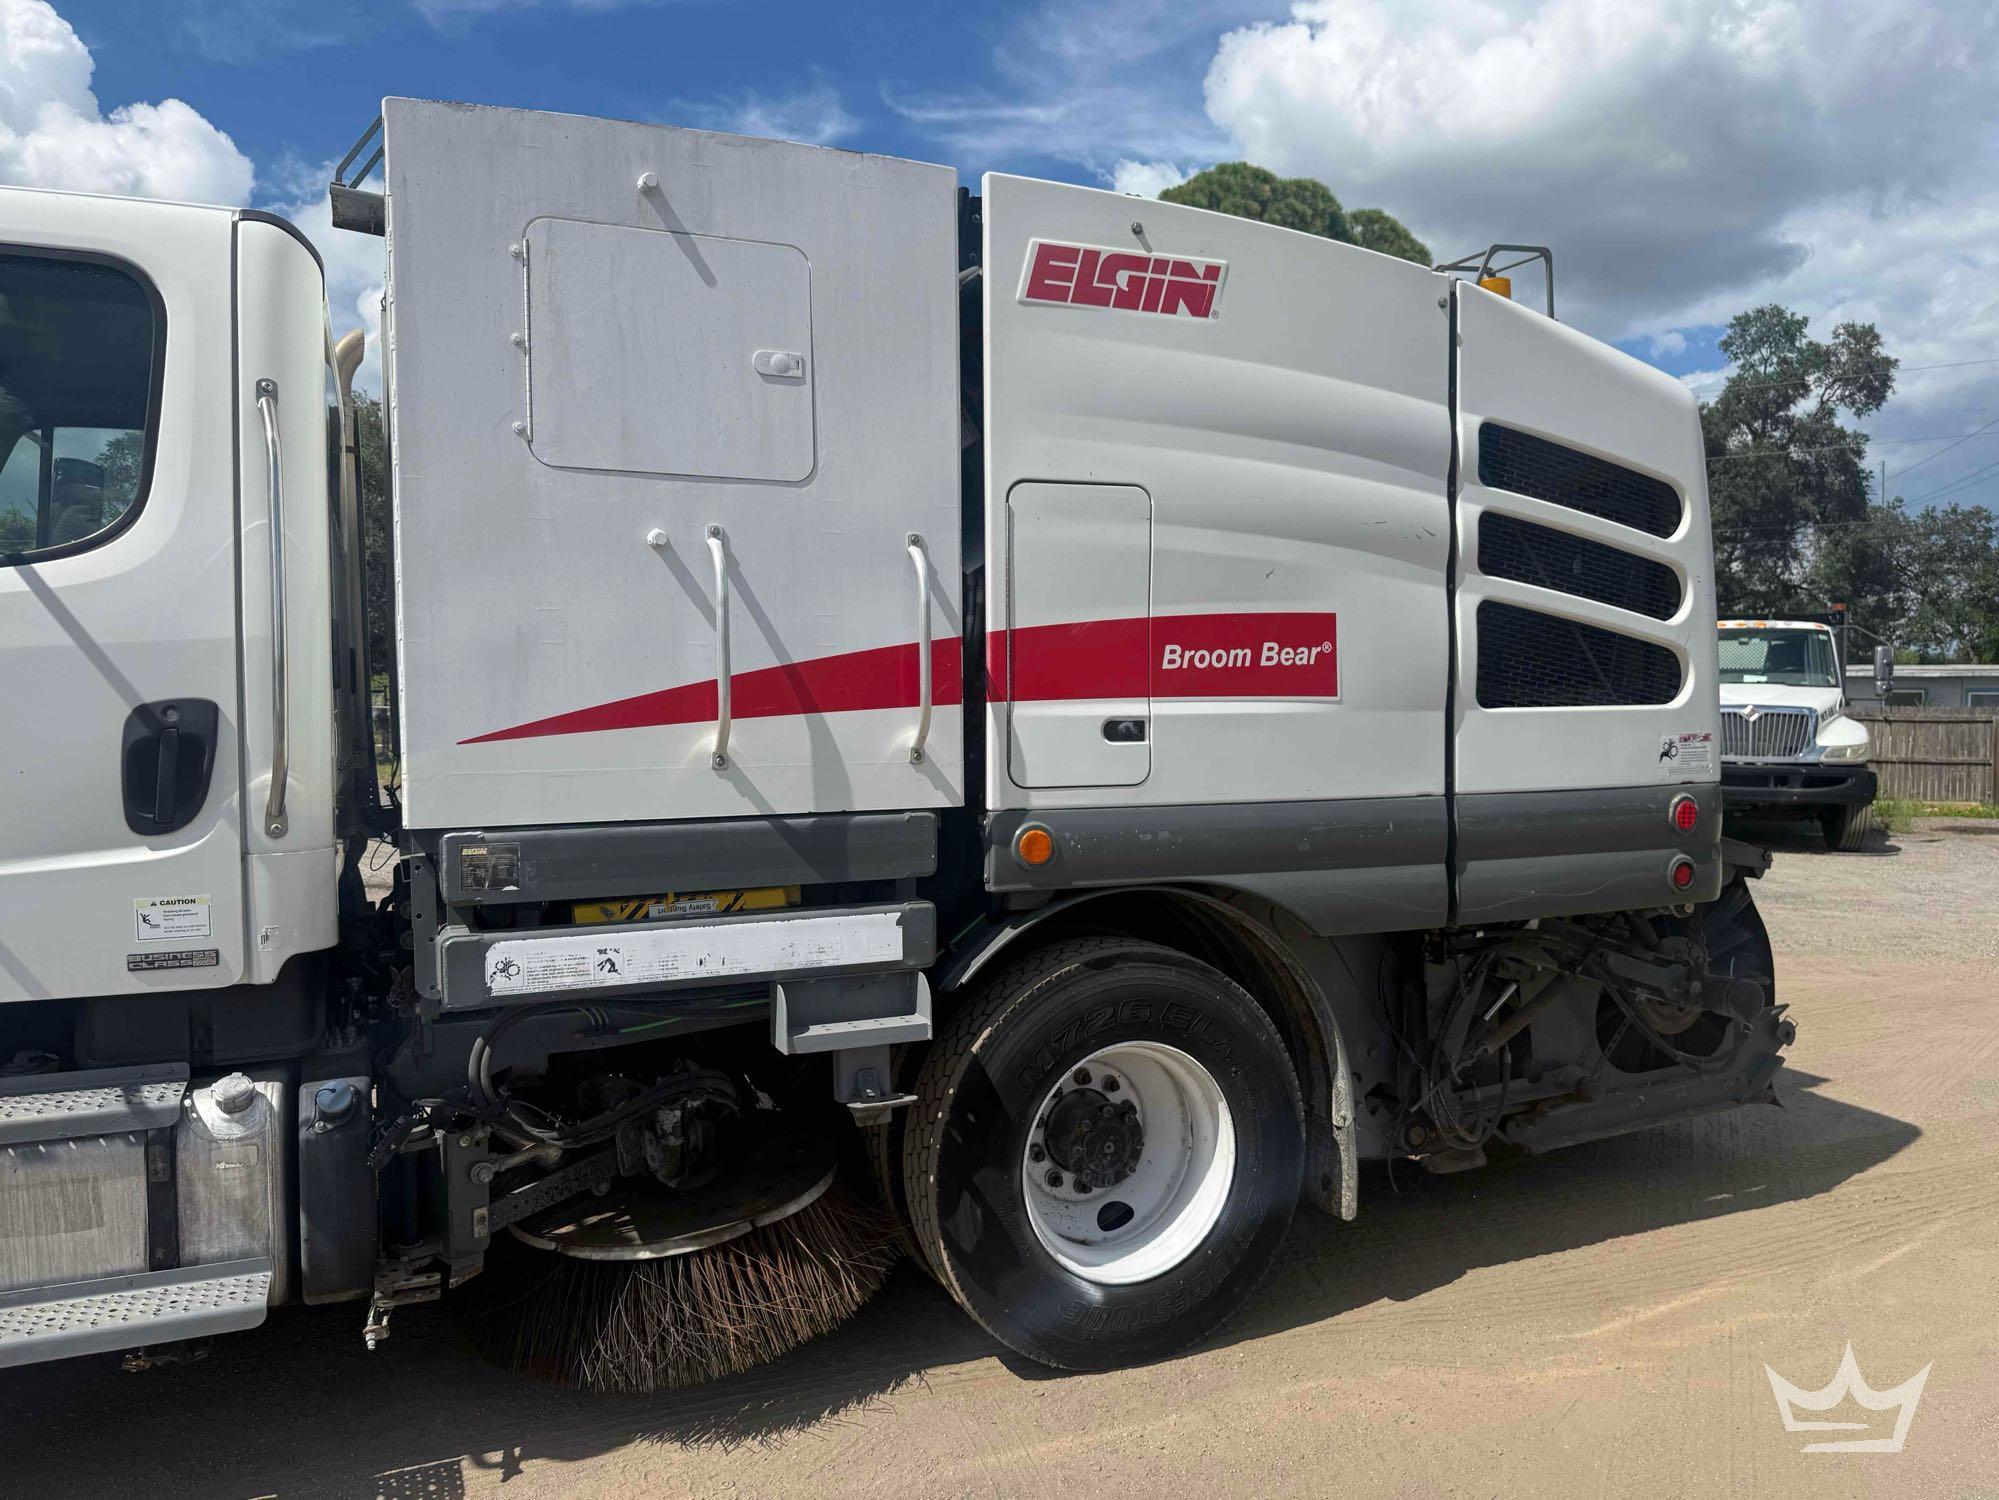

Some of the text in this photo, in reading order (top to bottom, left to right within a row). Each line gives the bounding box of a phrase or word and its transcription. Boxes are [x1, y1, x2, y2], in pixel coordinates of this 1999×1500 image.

[1162, 644, 1252, 669] Broom
[160, 898, 197, 906] CAUTION
[688, 902, 712, 912] Safety
[128, 951, 217, 962] BUSINESS
[128, 959, 193, 969] CLASS
